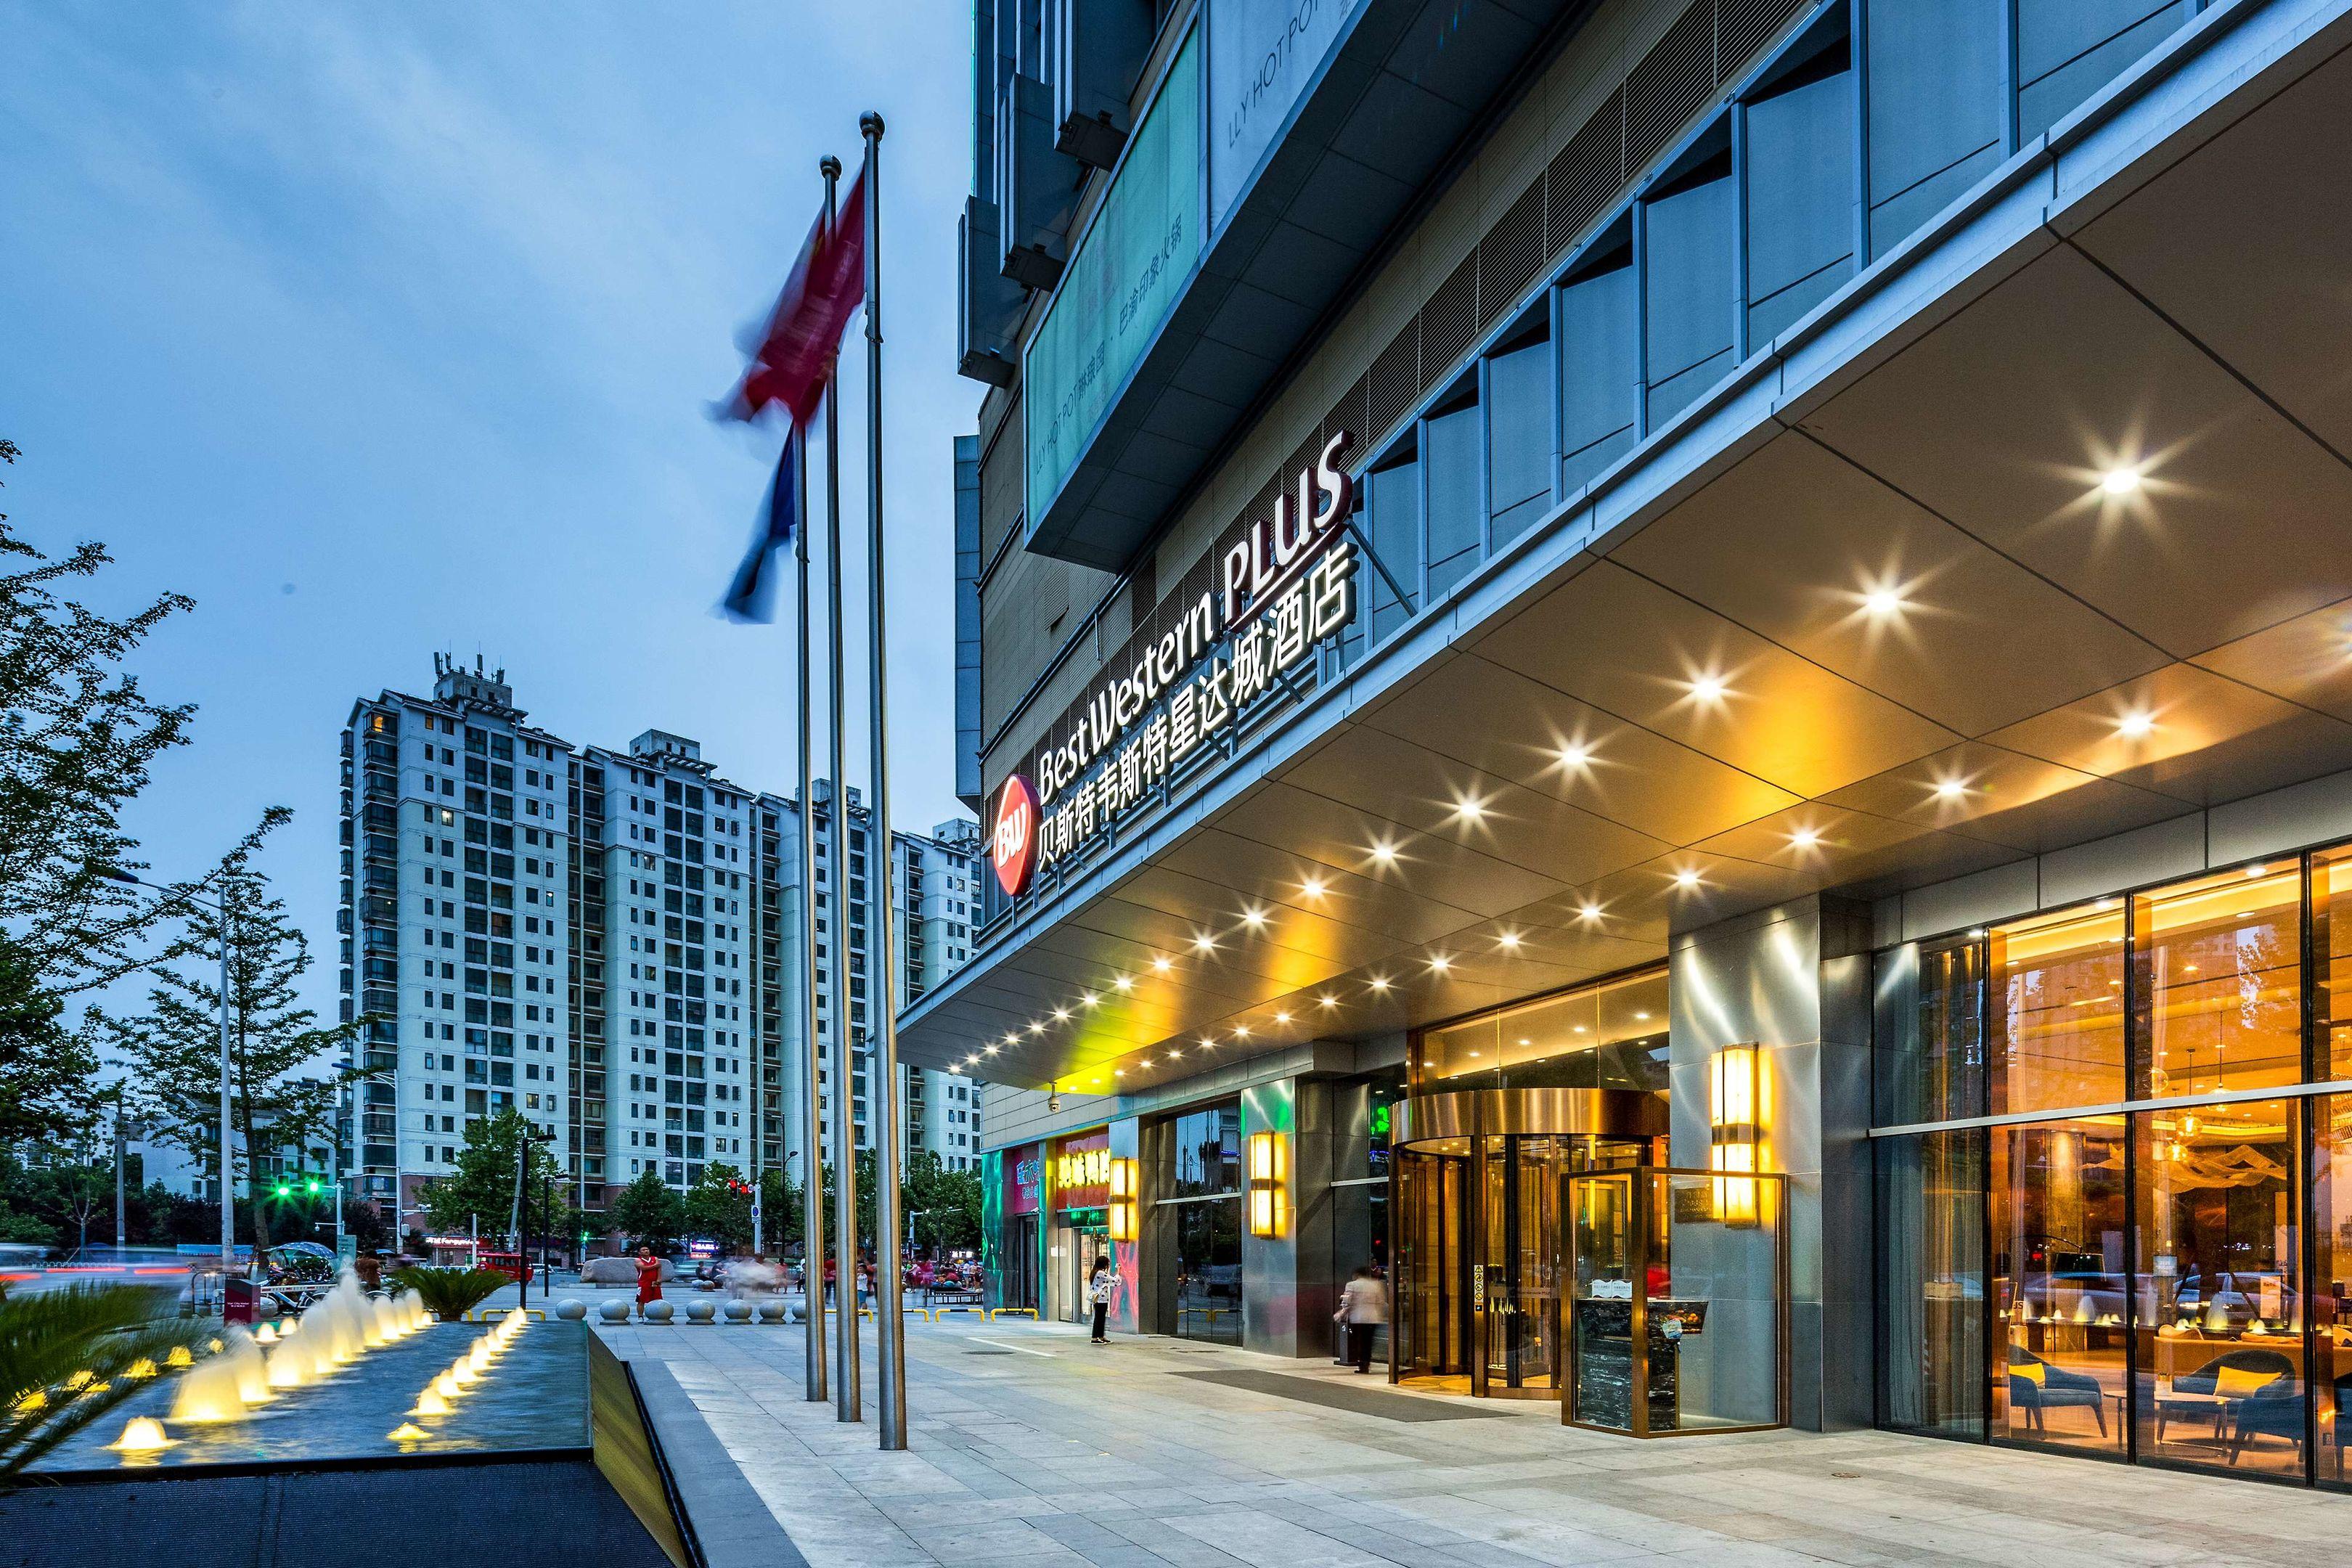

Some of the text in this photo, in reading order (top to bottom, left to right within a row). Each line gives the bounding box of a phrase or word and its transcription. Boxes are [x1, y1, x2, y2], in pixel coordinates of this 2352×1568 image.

[1254, 35, 1284, 107] HOT
[1048, 412, 1061, 454] HOT
[1063, 383, 1077, 427] POT
[1040, 430, 1342, 806] Best Western PLUS
[1038, 542, 1348, 872] 贝斯特韦斯特星达城酒店
[997, 802, 1026, 867] BW
